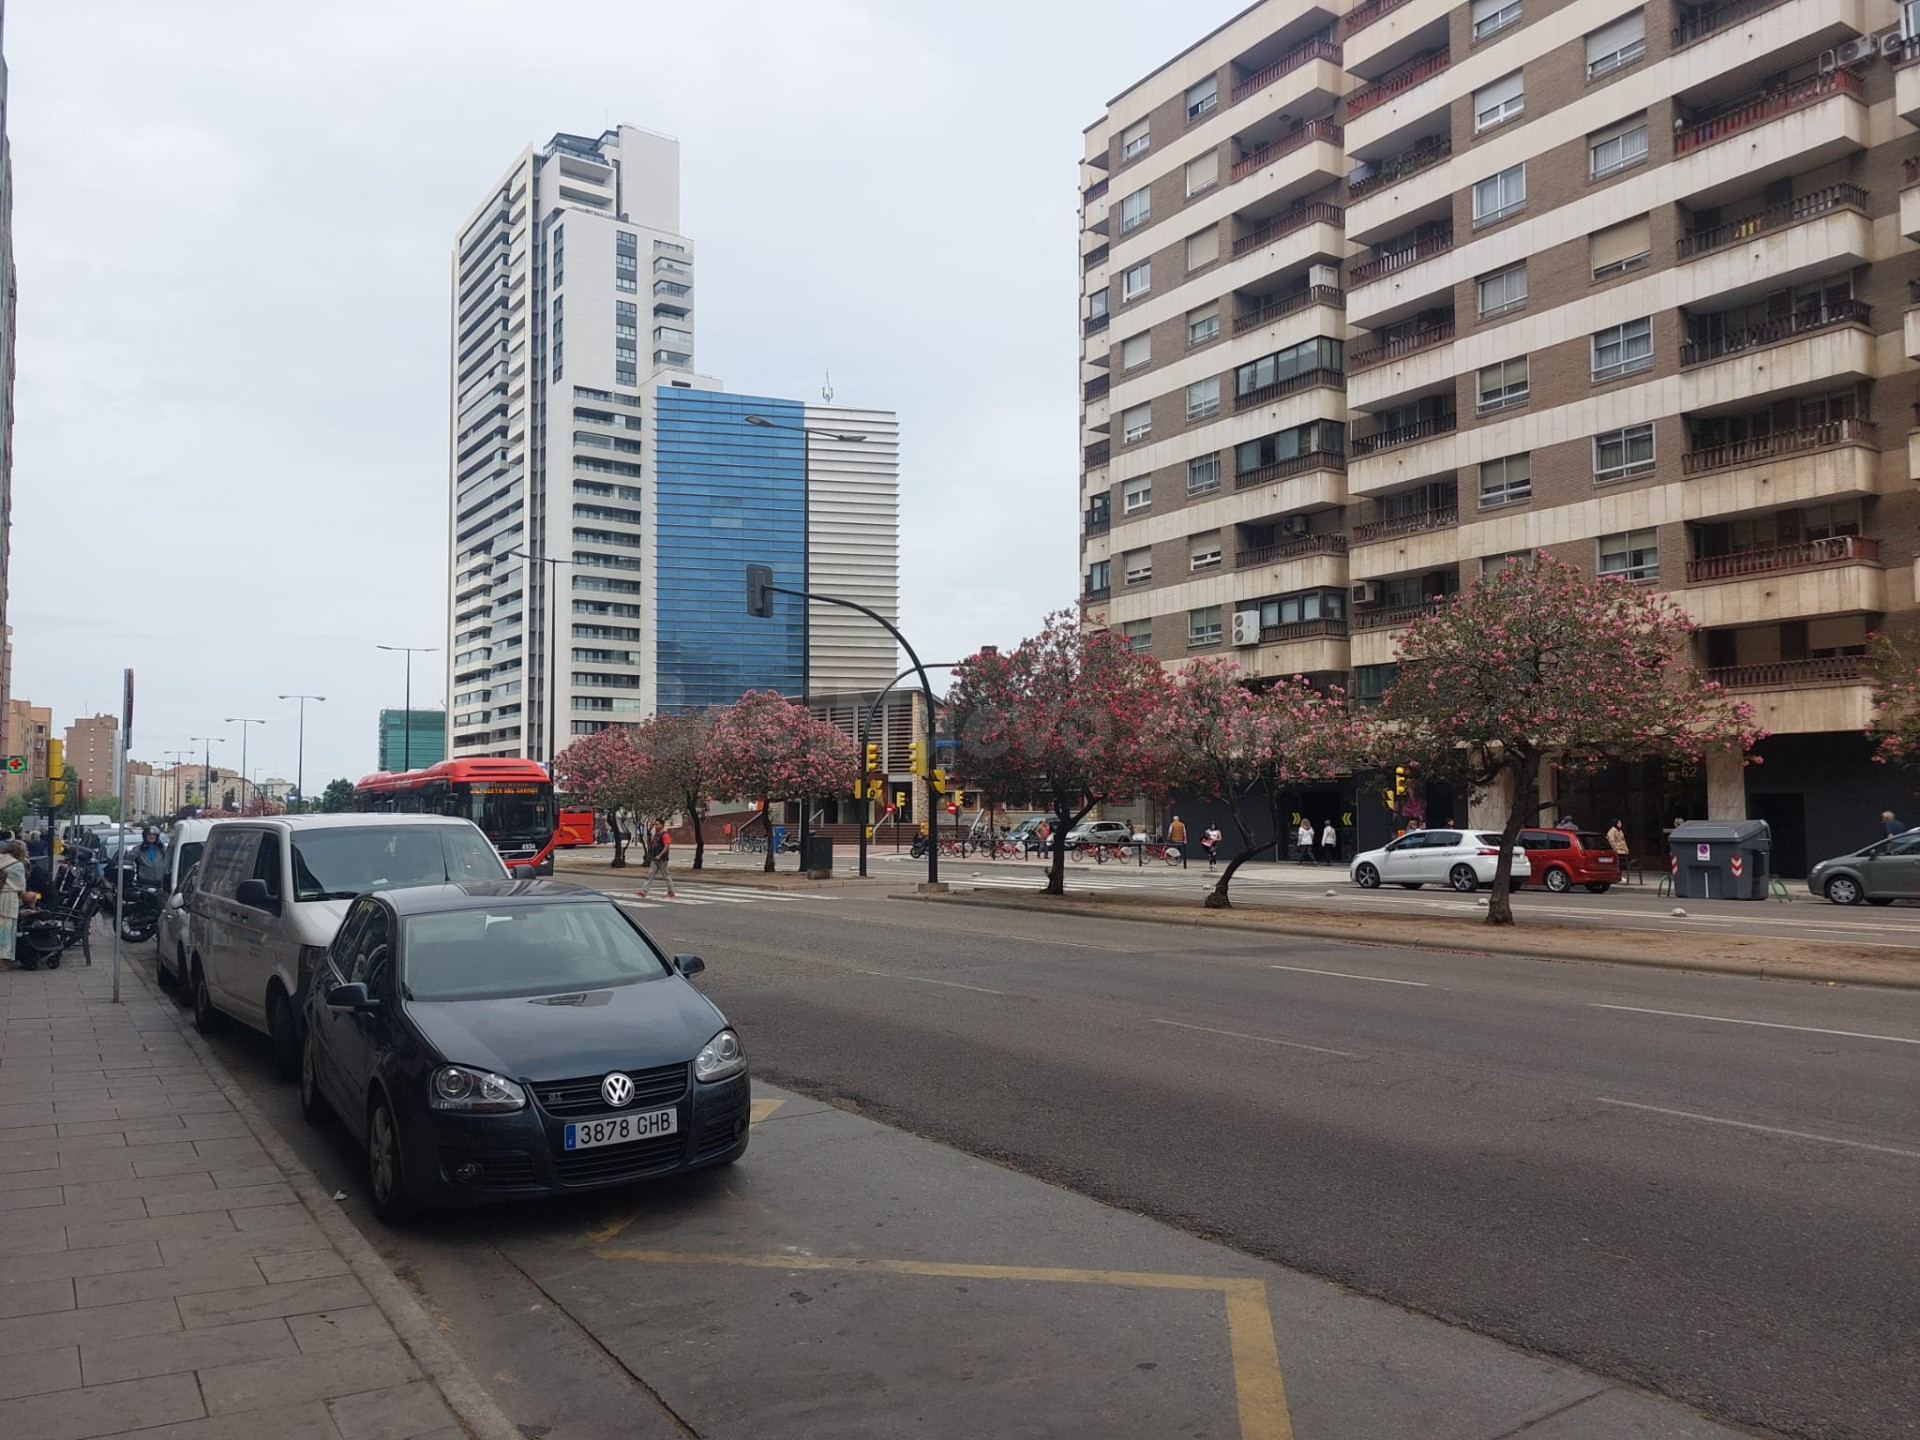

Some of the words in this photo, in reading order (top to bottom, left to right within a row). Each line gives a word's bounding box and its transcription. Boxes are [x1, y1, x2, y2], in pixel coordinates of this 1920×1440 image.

[1681, 766, 1697, 777] 52
[581, 1119, 630, 1144] 3878
[637, 1112, 671, 1135] GHB
